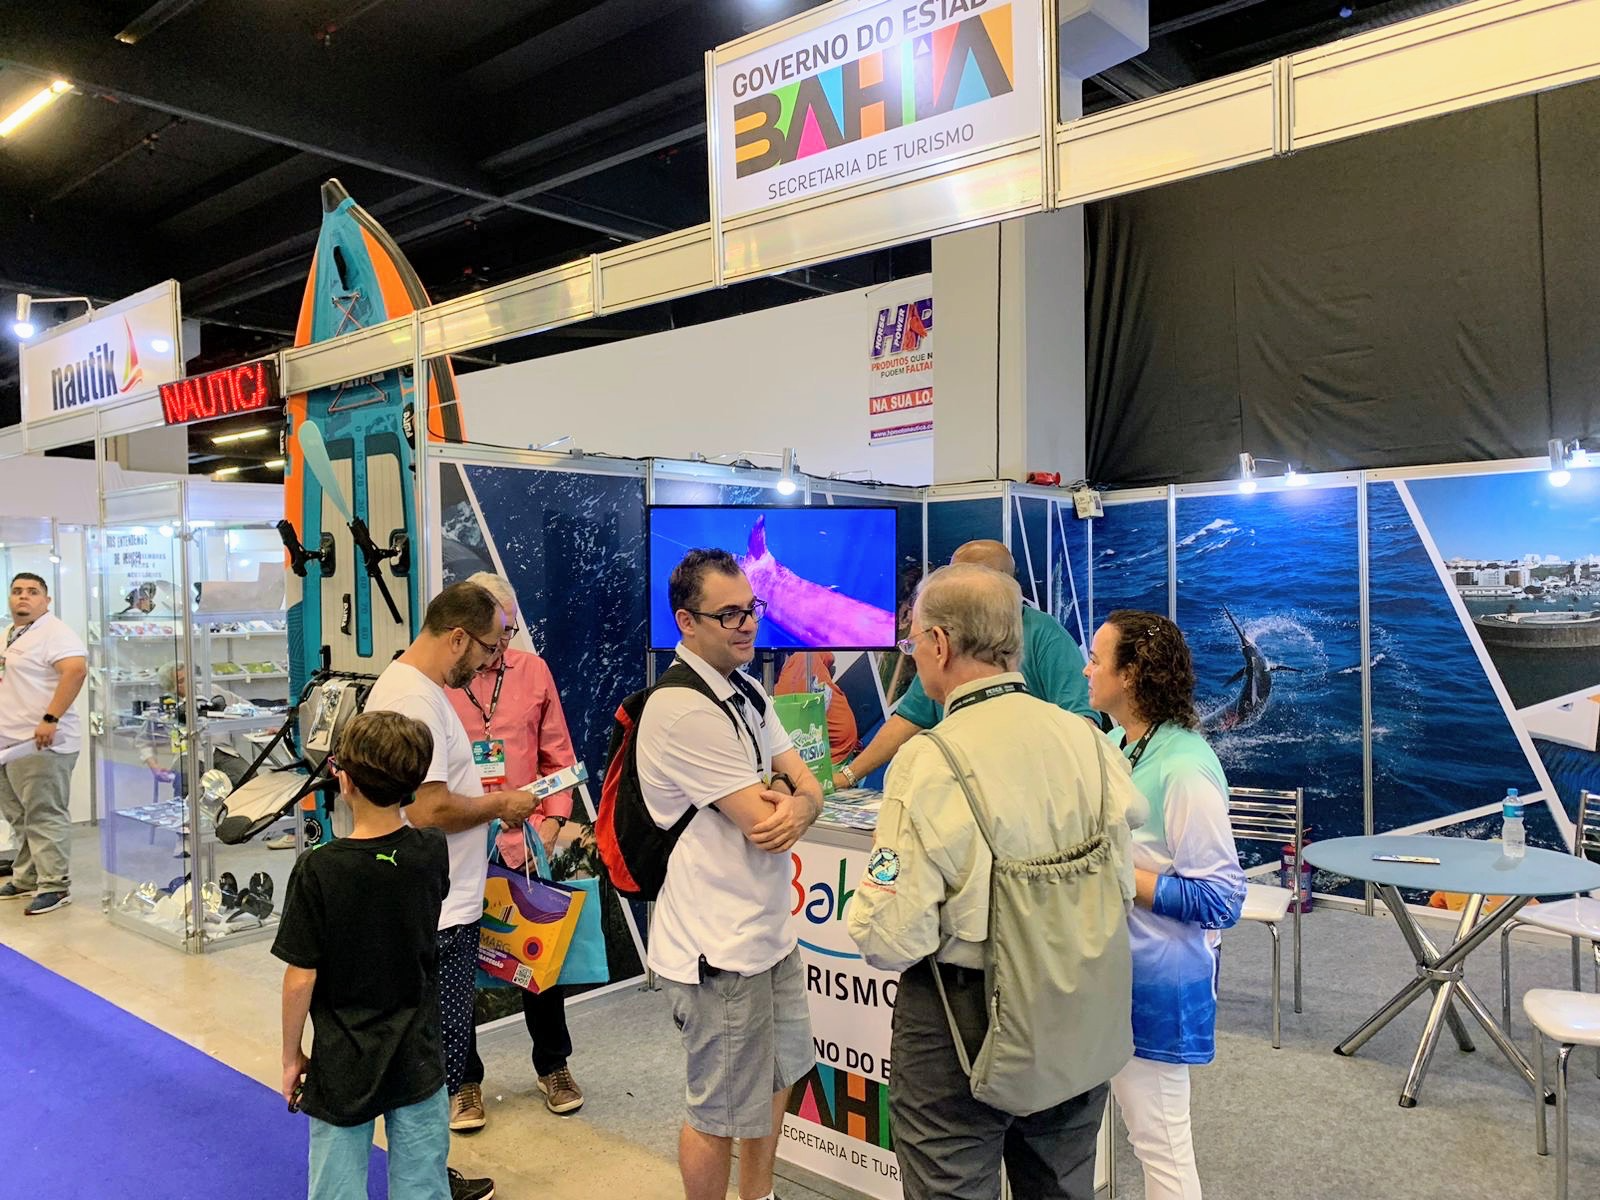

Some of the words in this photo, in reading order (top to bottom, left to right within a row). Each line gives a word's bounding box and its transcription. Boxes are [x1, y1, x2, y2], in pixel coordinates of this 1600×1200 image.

[732, 33, 848, 98] GOVERNO
[856, 16, 894, 51] DO
[734, 14, 1014, 180] BAHIA
[768, 157, 862, 200] SECRETARIA
[867, 149, 888, 168] DE
[893, 123, 975, 162] TURISMO
[875, 313, 886, 350] HORSE
[893, 308, 906, 347] POWER
[51, 342, 118, 411] nautik
[871, 356, 909, 371] PRODUTOS
[910, 353, 926, 363] QUE
[880, 367, 905, 378] PODEM
[872, 398, 888, 412] NA
[890, 393, 912, 409] SUA
[846, 1048, 875, 1074] DO
[779, 1124, 847, 1161] ECRETARIA
[851, 1150, 868, 1169] DE
